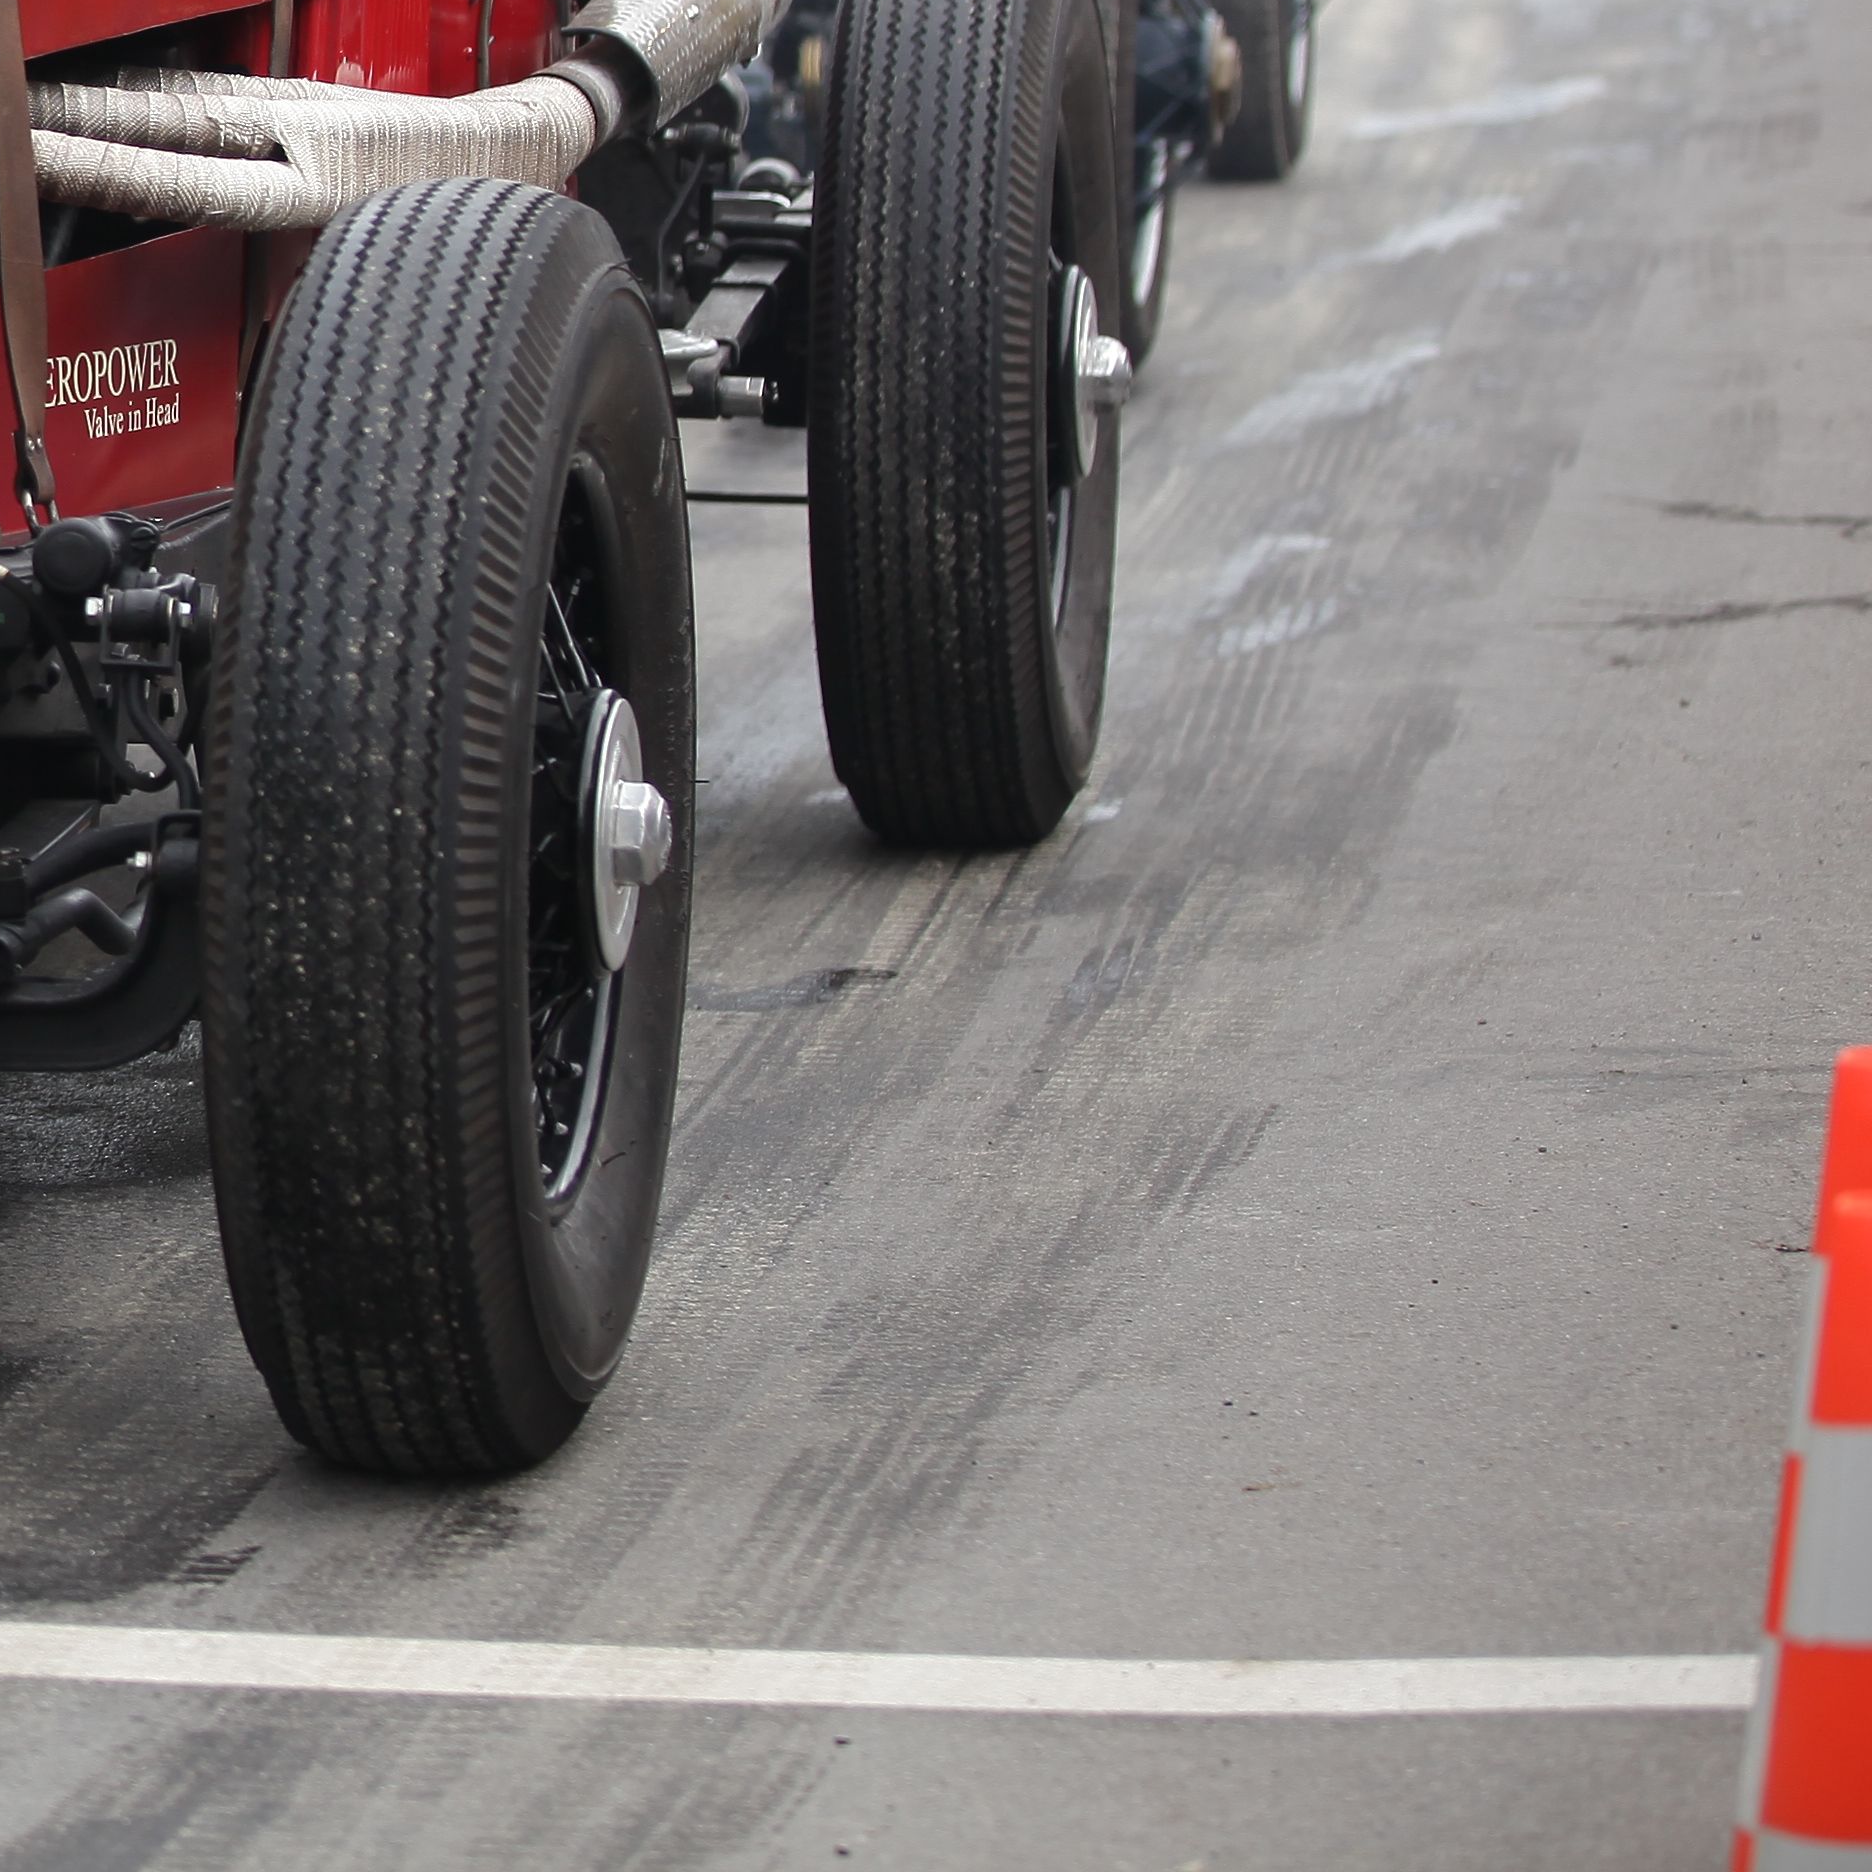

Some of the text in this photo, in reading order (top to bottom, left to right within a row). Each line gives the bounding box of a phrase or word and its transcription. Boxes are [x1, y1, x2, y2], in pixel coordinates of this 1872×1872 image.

[84, 392, 180, 439] Valve in Head
